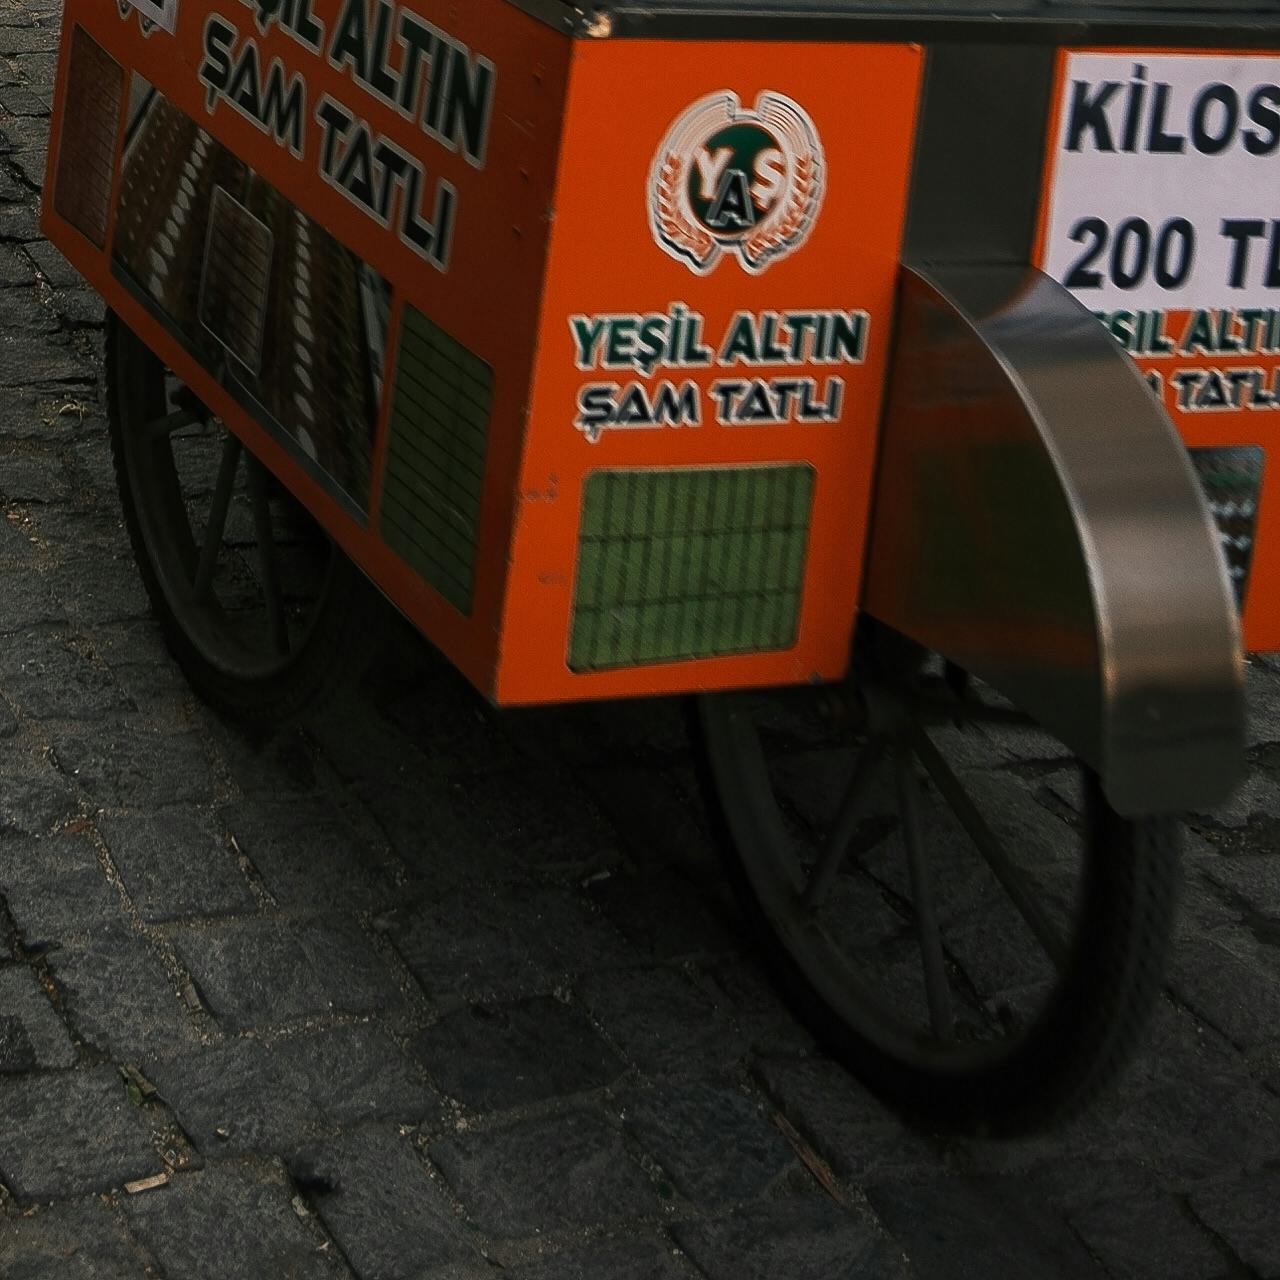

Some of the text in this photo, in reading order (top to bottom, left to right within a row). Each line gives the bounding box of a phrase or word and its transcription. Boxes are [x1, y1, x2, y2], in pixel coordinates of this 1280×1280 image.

[199, 13, 457, 274] ŞAM TATLI
[1063, 215, 1195, 291] 200
[569, 302, 871, 377] YEŞİL ALTIN
[573, 376, 845, 444] ŞAM TATLI
